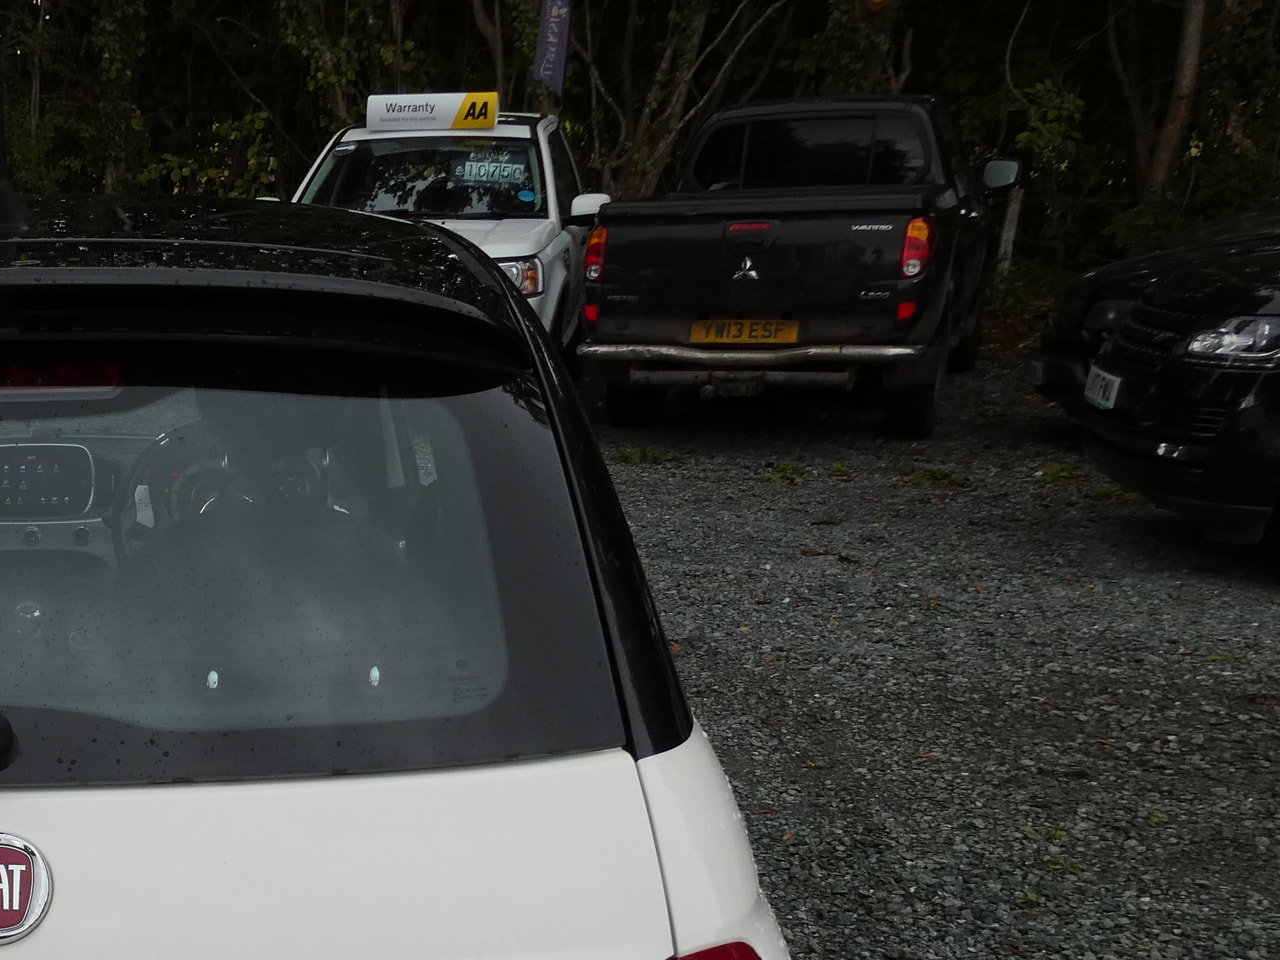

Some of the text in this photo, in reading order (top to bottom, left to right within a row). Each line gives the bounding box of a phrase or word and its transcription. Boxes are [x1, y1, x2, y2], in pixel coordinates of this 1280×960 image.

[385, 103, 436, 114] Warranty
[463, 101, 489, 121] AA
[704, 321, 744, 338] YW13
